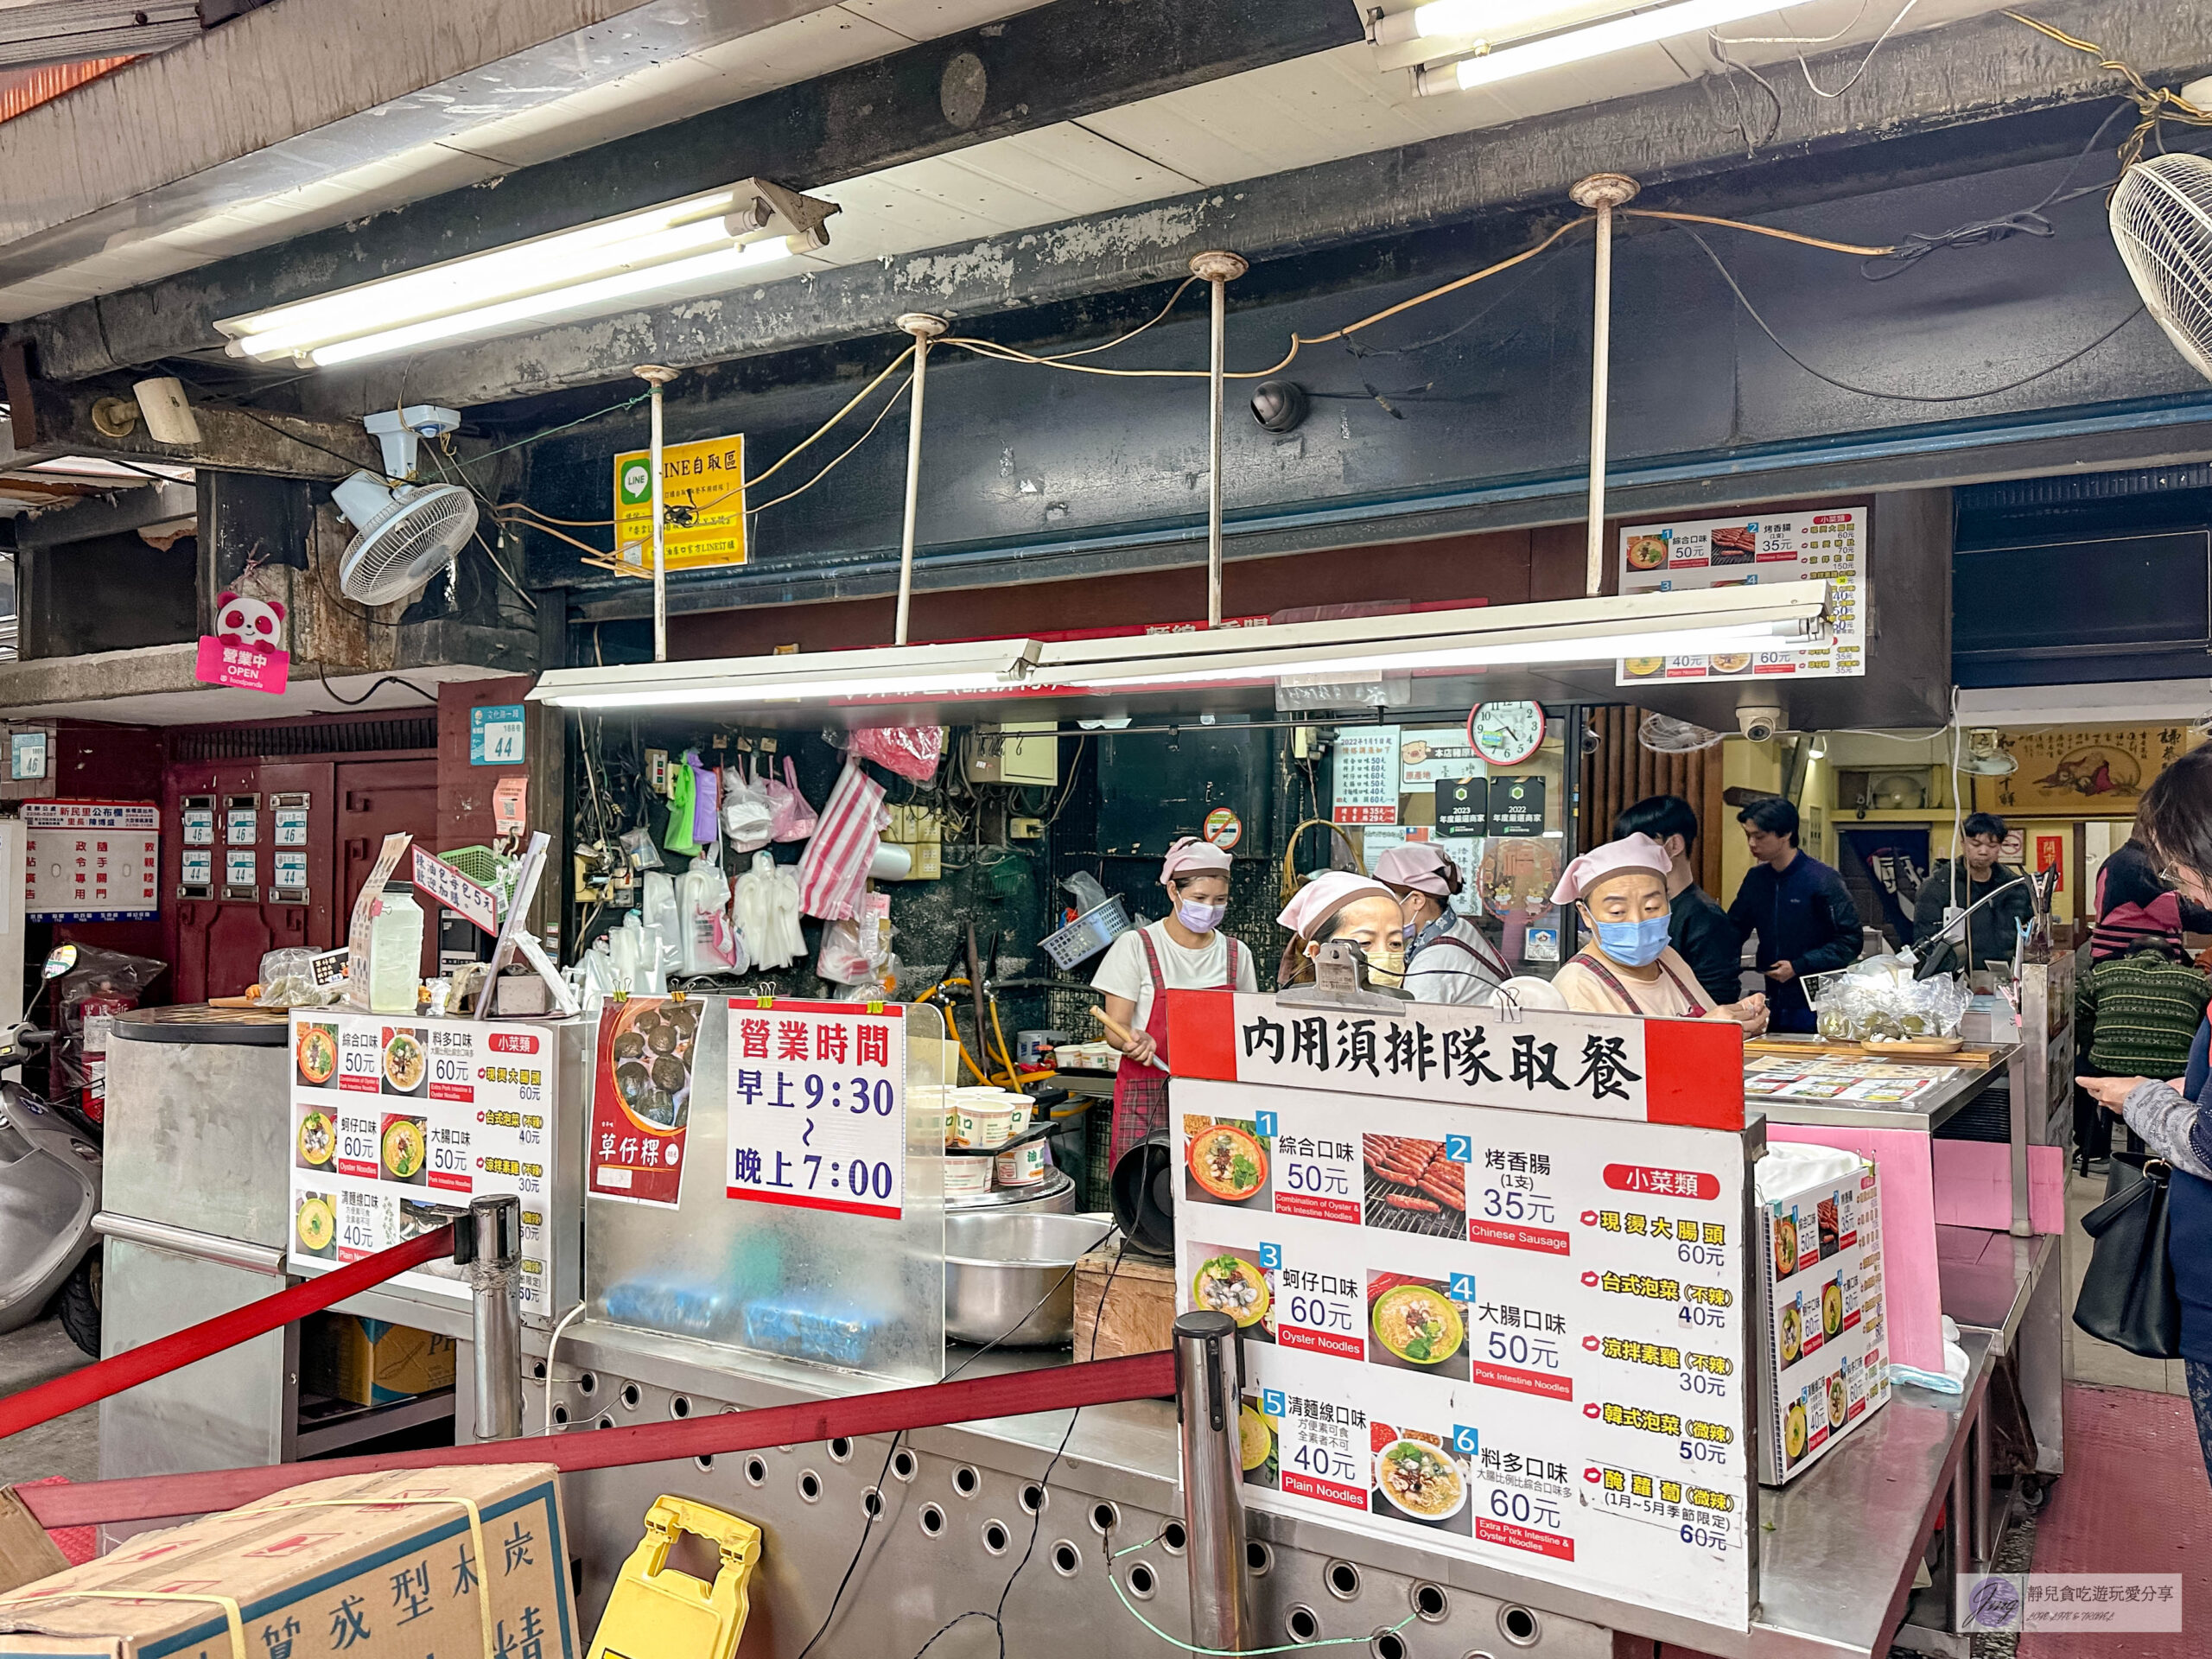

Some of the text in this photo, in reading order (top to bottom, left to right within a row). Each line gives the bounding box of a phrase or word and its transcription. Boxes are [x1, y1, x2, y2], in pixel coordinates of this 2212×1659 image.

[664, 450, 737, 479] INE自取區
[627, 475, 645, 486] LINE
[1749, 523, 1758, 533] 2
[1764, 524, 1791, 533] 烤香腸
[1672, 535, 1708, 545] 綜合口味
[1763, 539, 1792, 551] 35元
[1675, 545, 1704, 558] 50元
[1662, 582, 1670, 591] 3
[1748, 575, 1757, 584] 4
[1833, 591, 1853, 601] 40元
[1833, 606, 1853, 615] 50元
[223, 647, 267, 668] 營業中
[1673, 655, 1702, 667] 40元
[1760, 652, 1790, 664] 60元
[227, 665, 258, 679] OPEN
[230, 677, 263, 688] foodpanda
[487, 709, 518, 720] 文化路一段
[1481, 712, 1491, 721] 10
[1527, 709, 1533, 718] 2
[1478, 725, 1484, 734] 9
[1531, 721, 1537, 731] 3
[495, 737, 512, 757] 44
[1517, 744, 1523, 753] 5
[1527, 734, 1533, 744] 4
[1504, 748, 1510, 758] 6
[27, 757, 38, 773] 46
[60, 807, 123, 817] 新民里公布欄
[1440, 814, 1485, 823] 年度嚴選商家
[1493, 814, 1541, 823] 年度嚴選商家
[193, 829, 202, 841] 46
[236, 829, 245, 841] 46
[284, 829, 296, 842] 46
[75, 841, 86, 899] 政令專用
[96, 842, 108, 899] 隨手關門
[190, 868, 200, 880] 44
[236, 869, 245, 881] 44
[284, 871, 296, 884] 44
[416, 853, 493, 913] 辣油包每包5元
[342, 1033, 378, 1049] 綜合口味
[432, 1031, 474, 1048] 料多口味
[499, 1035, 531, 1052] 小菜類
[741, 1018, 890, 1068] 營業時間
[346, 1052, 375, 1073] 50元
[1242, 1015, 1643, 1102] 內用須排隊取餐
[436, 1059, 468, 1081] 60元
[519, 1086, 540, 1100] 60元
[737, 1068, 894, 1117] 早上9:30
[341, 1117, 378, 1135] 蚵仔口味
[486, 1109, 520, 1128] 台式泡菜
[1261, 1114, 1271, 1135] 1
[345, 1136, 373, 1158] 60元
[431, 1128, 471, 1147] 大腸口味
[519, 1130, 540, 1144] 40元
[599, 1133, 659, 1166] 草仔粿
[1279, 1135, 1354, 1162] 綜合口味
[1450, 1137, 1468, 1160] 2
[340, 1162, 377, 1175] Oyster Noodles
[435, 1148, 467, 1171] 50元
[1485, 1147, 1551, 1176] 烤香腸
[735, 1147, 893, 1199] 晚上7:00
[1287, 1163, 1348, 1194] 50元
[1501, 1173, 1534, 1192] (1支)
[1626, 1167, 1698, 1197] 小菜類
[518, 1178, 539, 1193] 30元
[1276, 1193, 1319, 1206] Combination
[1328, 1201, 1351, 1212] Oyster
[1276, 1204, 1353, 1221] Pork Intestine Noodles
[1484, 1189, 1554, 1224] 35元
[1600, 1210, 1726, 1246] 現燙大腸頭
[1841, 1213, 1854, 1233] 35元
[344, 1224, 372, 1248] 40元
[1471, 1225, 1567, 1249] Chinese Sausage
[1802, 1230, 1815, 1252] 50元
[1263, 1245, 1278, 1267] 3
[1678, 1243, 1725, 1267] 60元
[1282, 1268, 1358, 1299] 蚵仔口味
[1452, 1276, 1472, 1300] 4
[1601, 1270, 1733, 1308] 台式泡菜 (不辣)
[1291, 1296, 1351, 1330] 60元
[1846, 1292, 1859, 1313] 50元
[1478, 1302, 1566, 1335] 大腸口味
[1679, 1306, 1726, 1328] 40元
[1806, 1314, 1820, 1337] 60元
[1282, 1330, 1360, 1354] Oyster Noodles
[1488, 1331, 1559, 1369] 50元
[1602, 1337, 1733, 1376] 涼拌素雞 (不辣)
[1476, 1368, 1570, 1394] Pork Intestine Noodles
[1679, 1372, 1726, 1397] 30元
[1850, 1379, 1862, 1402] 60元
[1267, 1392, 1281, 1414] 5
[1288, 1395, 1367, 1429] 清麵線口味
[1298, 1418, 1349, 1438] 方便素可食
[1602, 1402, 1681, 1437] 韓式泡菜
[1811, 1408, 1825, 1431] 40元
[1298, 1430, 1349, 1451] 全素者不可
[1457, 1428, 1475, 1452] 6
[1294, 1444, 1355, 1480] 40元
[1679, 1440, 1726, 1465] 50元
[1481, 1447, 1567, 1484] 料多口味
[1285, 1477, 1363, 1504] Plain Noodles
[1477, 1469, 1572, 1498] 大腸比例比綜合口味多
[1603, 1467, 1681, 1503] 醃蘿蔔
[1491, 1489, 1560, 1529] 60元
[1479, 1519, 1569, 1548] Extra Pork Intestine &
[1479, 1529, 1543, 1551] Oyster Noodles
[1680, 1524, 1726, 1551] 60元
